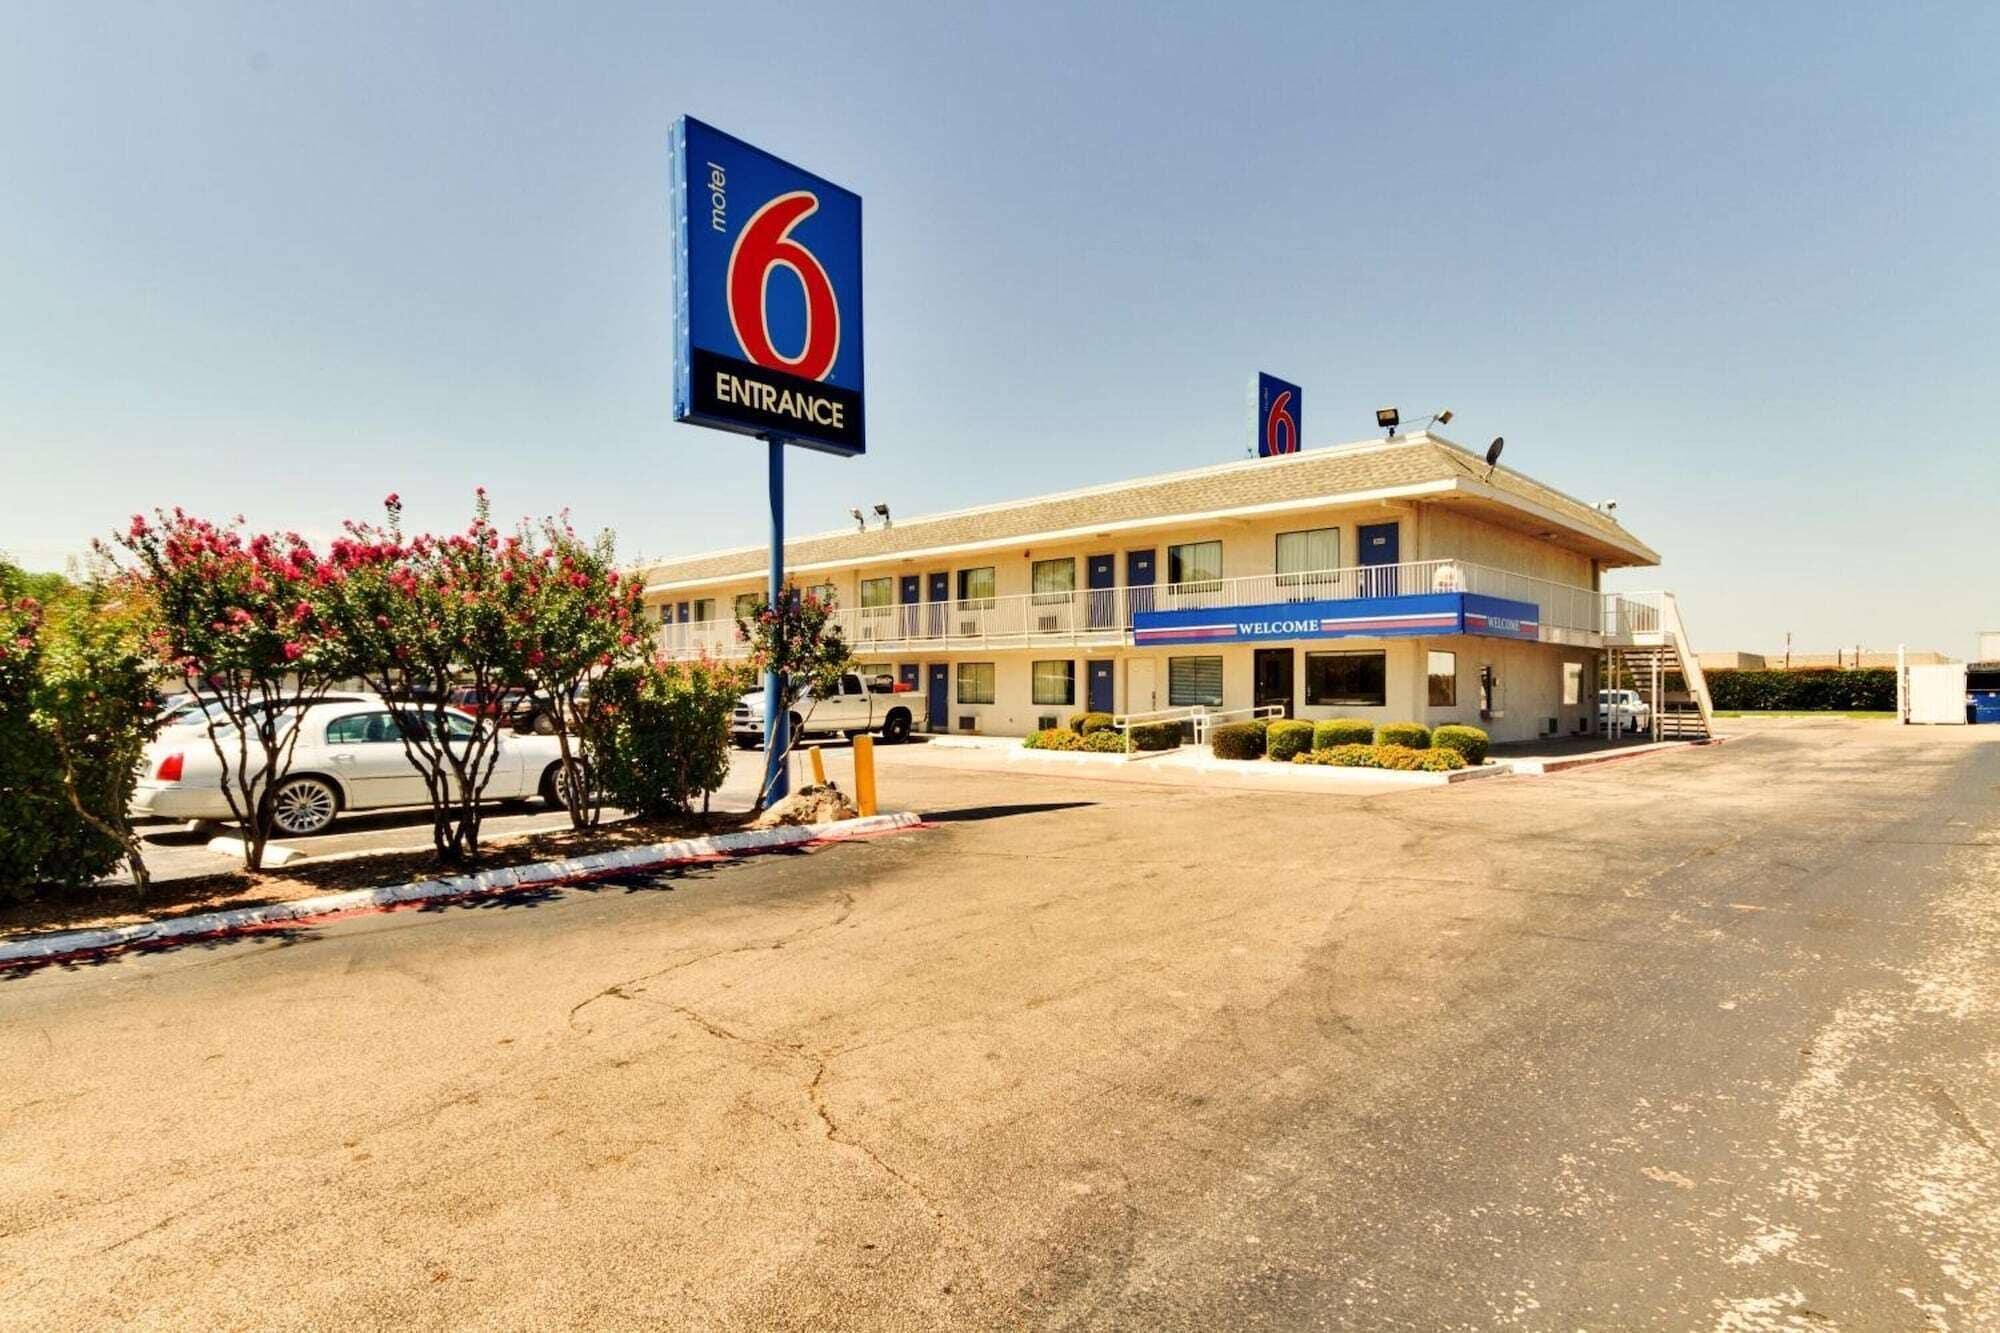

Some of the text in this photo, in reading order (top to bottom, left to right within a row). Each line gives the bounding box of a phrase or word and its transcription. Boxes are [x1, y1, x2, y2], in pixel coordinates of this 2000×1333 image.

[707, 162, 726, 232] motel
[727, 191, 840, 382] 6
[717, 373, 843, 428] ENTRANCE
[1267, 390, 1296, 456] 6
[1239, 619, 1320, 635] WELCOME
[1487, 615, 1521, 632] WELCOME
